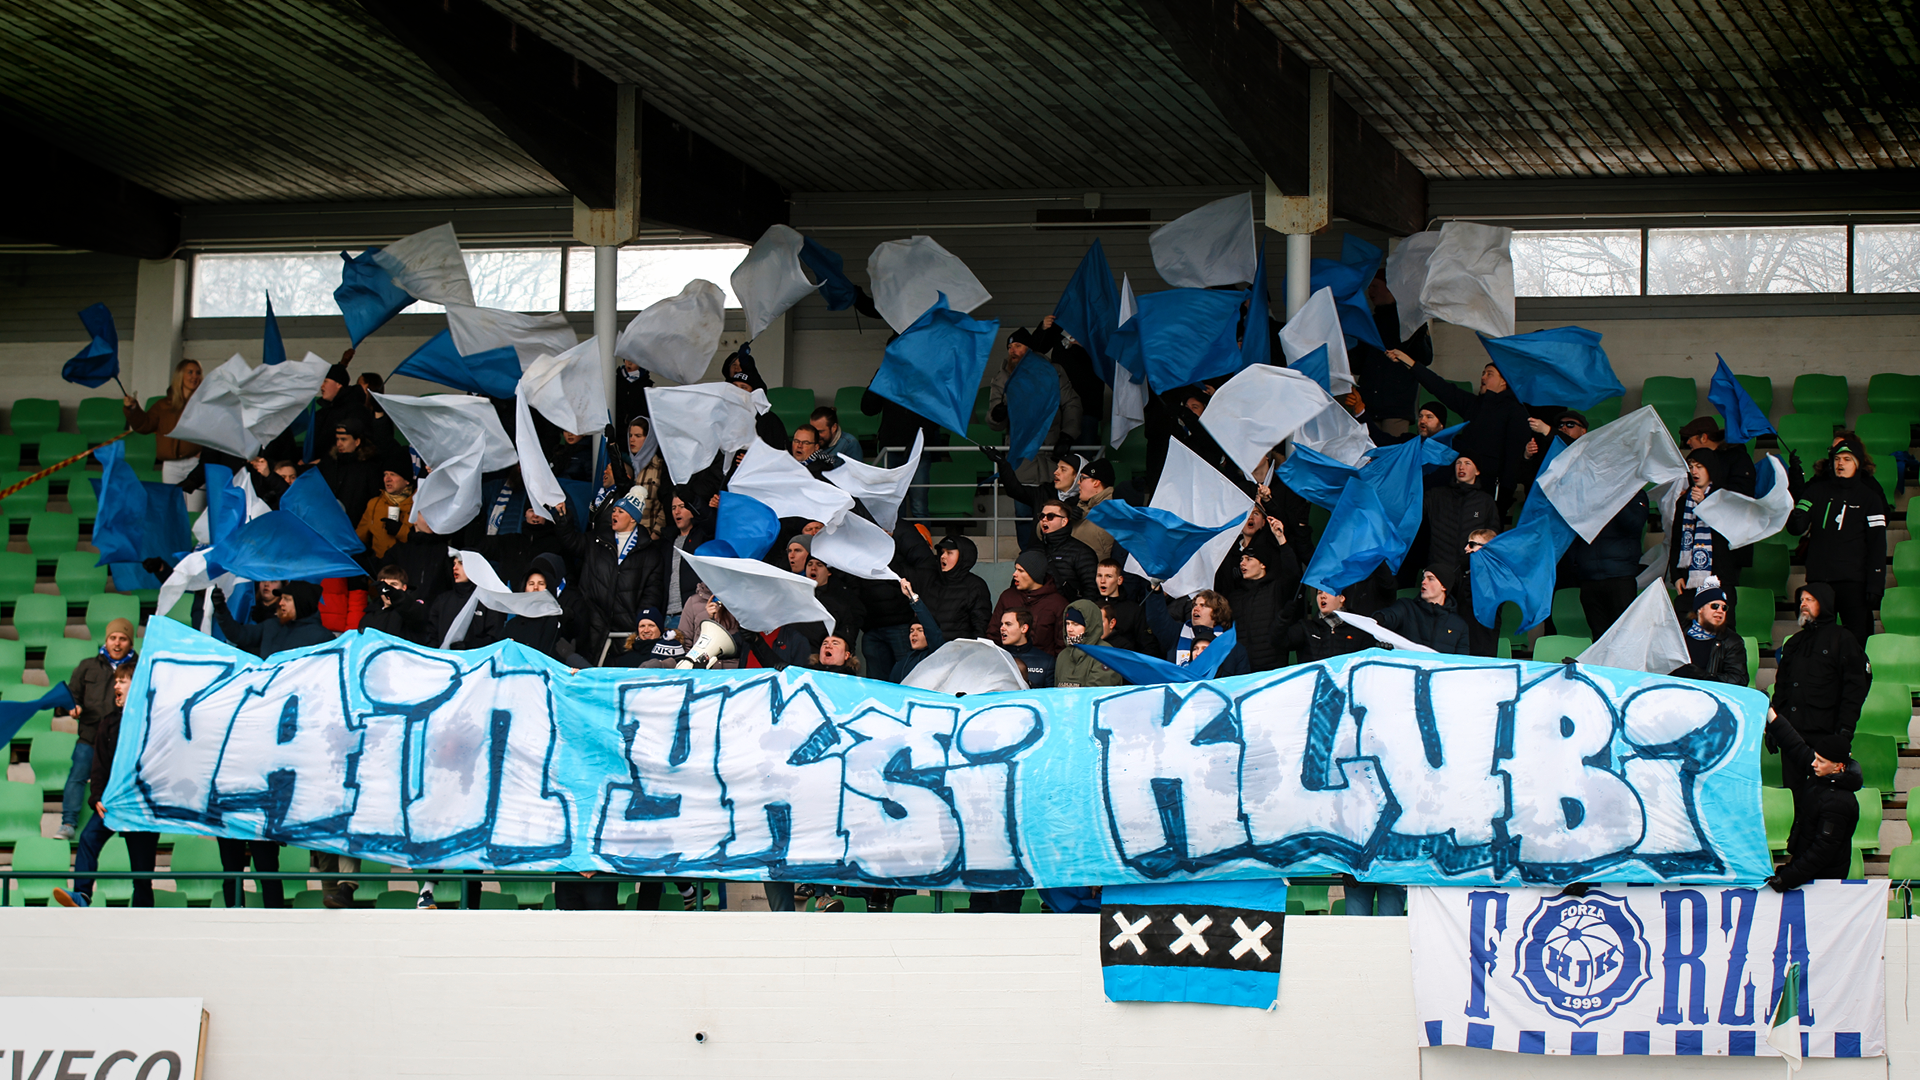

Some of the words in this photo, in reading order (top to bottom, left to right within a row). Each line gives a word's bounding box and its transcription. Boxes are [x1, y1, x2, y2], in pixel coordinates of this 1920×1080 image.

[1560, 904, 1606, 922] FORZA
[1545, 944, 1619, 988] HJK
[1561, 996, 1602, 1010] 1999
[0, 1049, 182, 1080] VECO
